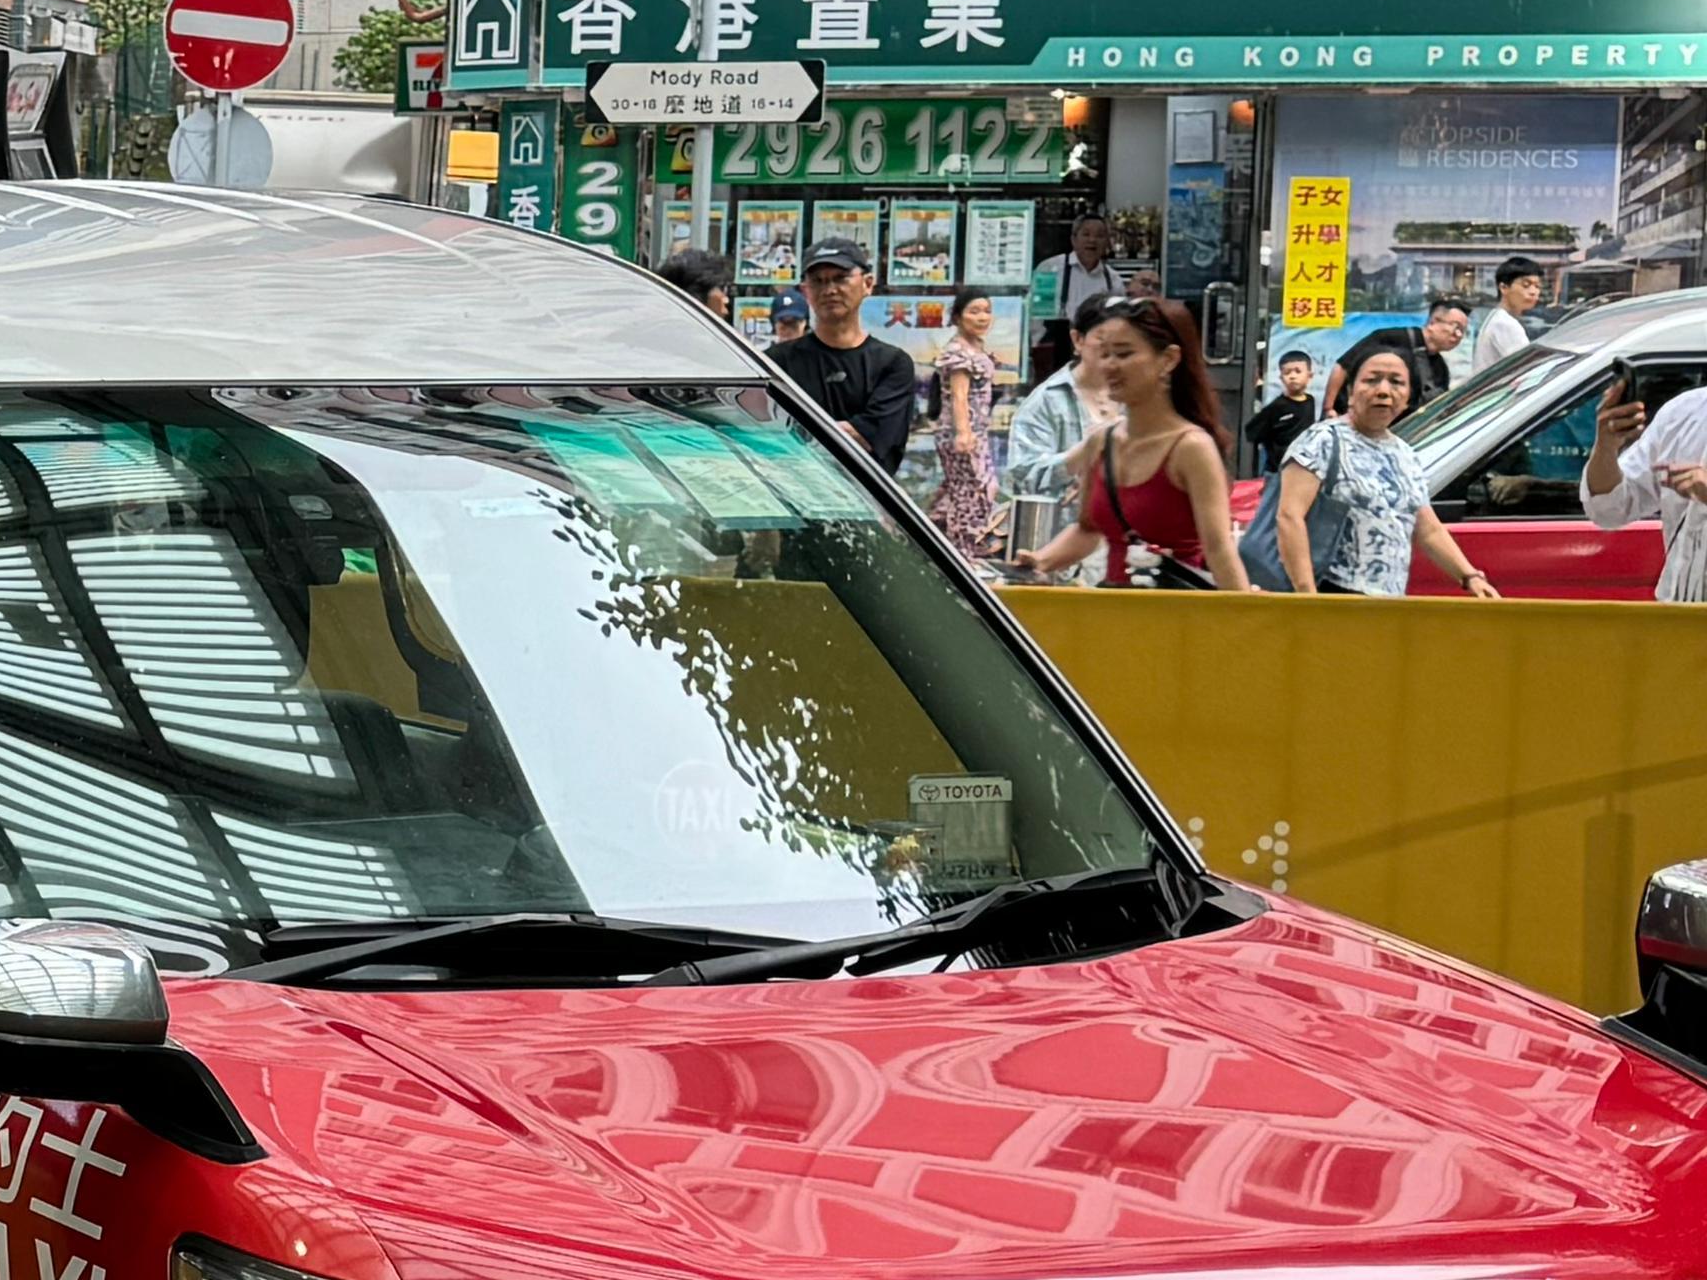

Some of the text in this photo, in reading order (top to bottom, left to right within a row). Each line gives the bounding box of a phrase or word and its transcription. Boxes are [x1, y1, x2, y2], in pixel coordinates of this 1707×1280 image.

[1067, 41, 1699, 68] HONG KONG PROPERTY
[651, 70, 759, 87] Mody Road
[904, 104, 1057, 176] 1122
[1427, 126, 1528, 146] TOPSIDE
[1426, 148, 1579, 169] RESIDENCES
[1295, 186, 1344, 207] 子女
[1292, 223, 1342, 246] 升學
[1290, 261, 1340, 283] 人才
[1289, 297, 1338, 319] 移民
[943, 783, 1003, 799] TOYOTA
